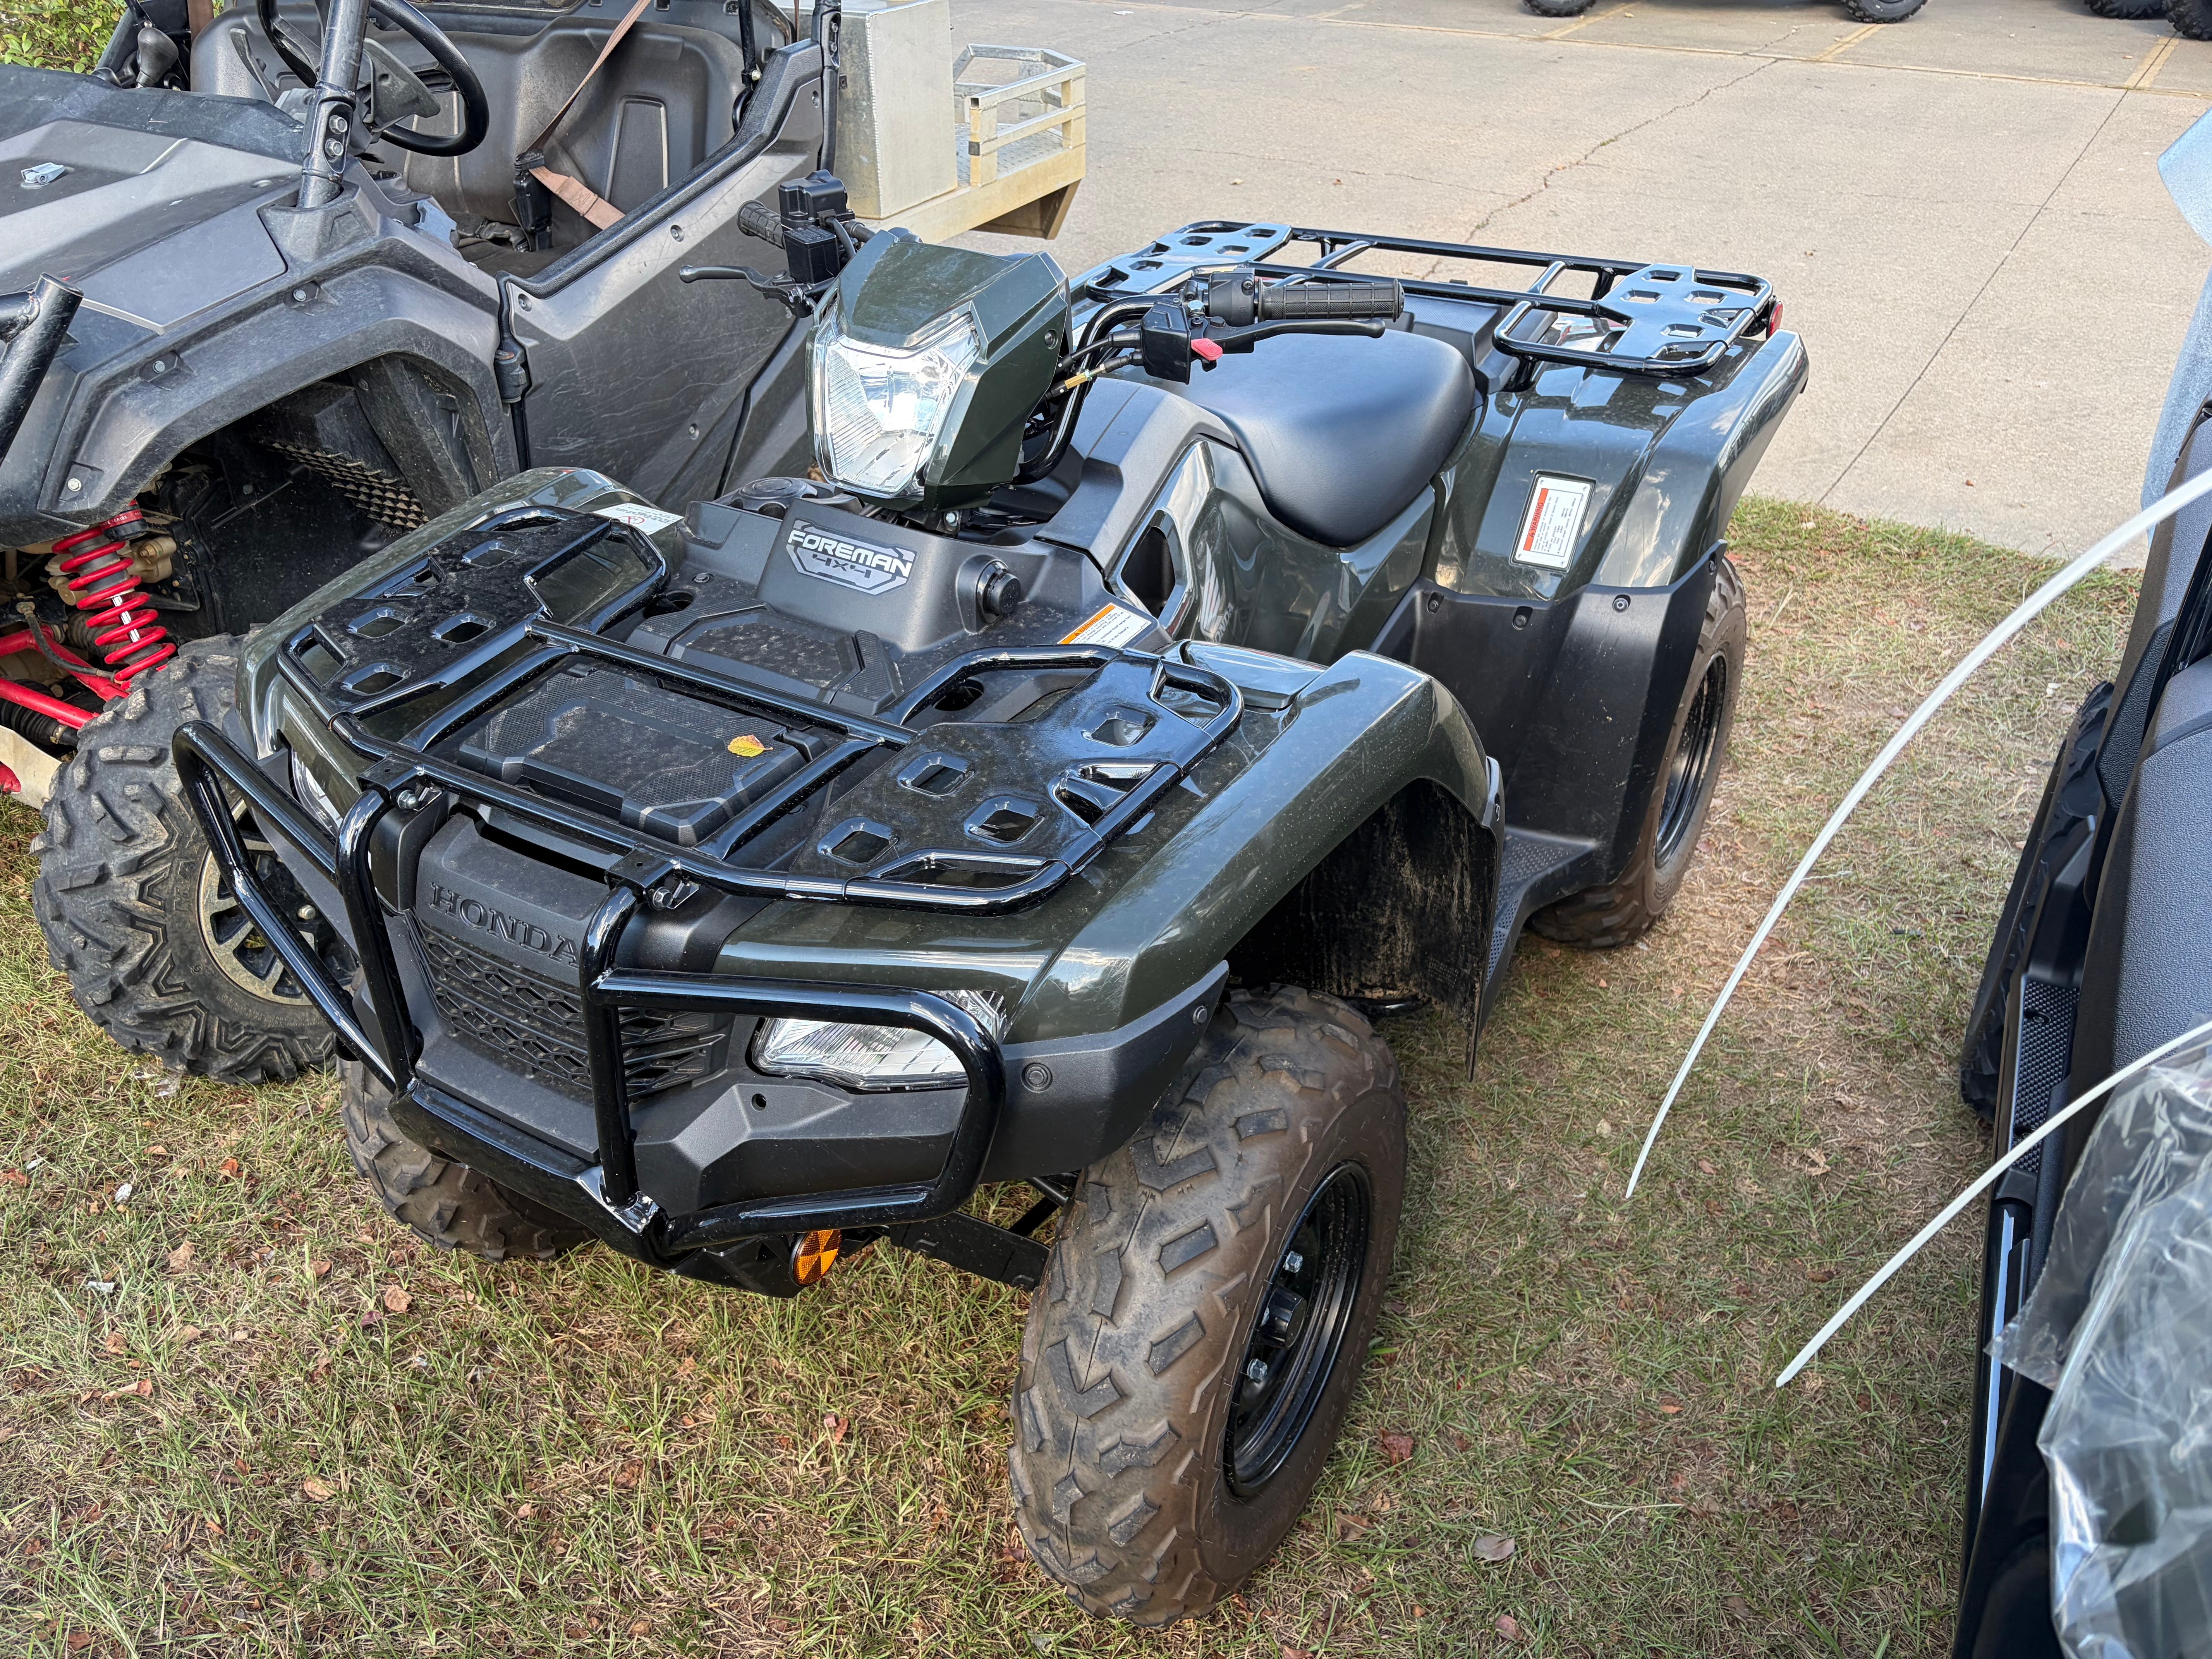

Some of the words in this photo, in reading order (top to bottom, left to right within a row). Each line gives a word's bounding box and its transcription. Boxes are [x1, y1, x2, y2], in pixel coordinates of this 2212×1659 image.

[1530, 502, 1543, 531] WARNING
[788, 530, 912, 577] FOREMAN
[1077, 617, 1098, 632] WARNING
[1215, 603, 1234, 643] ONDA
[432, 882, 580, 968] HONDA
